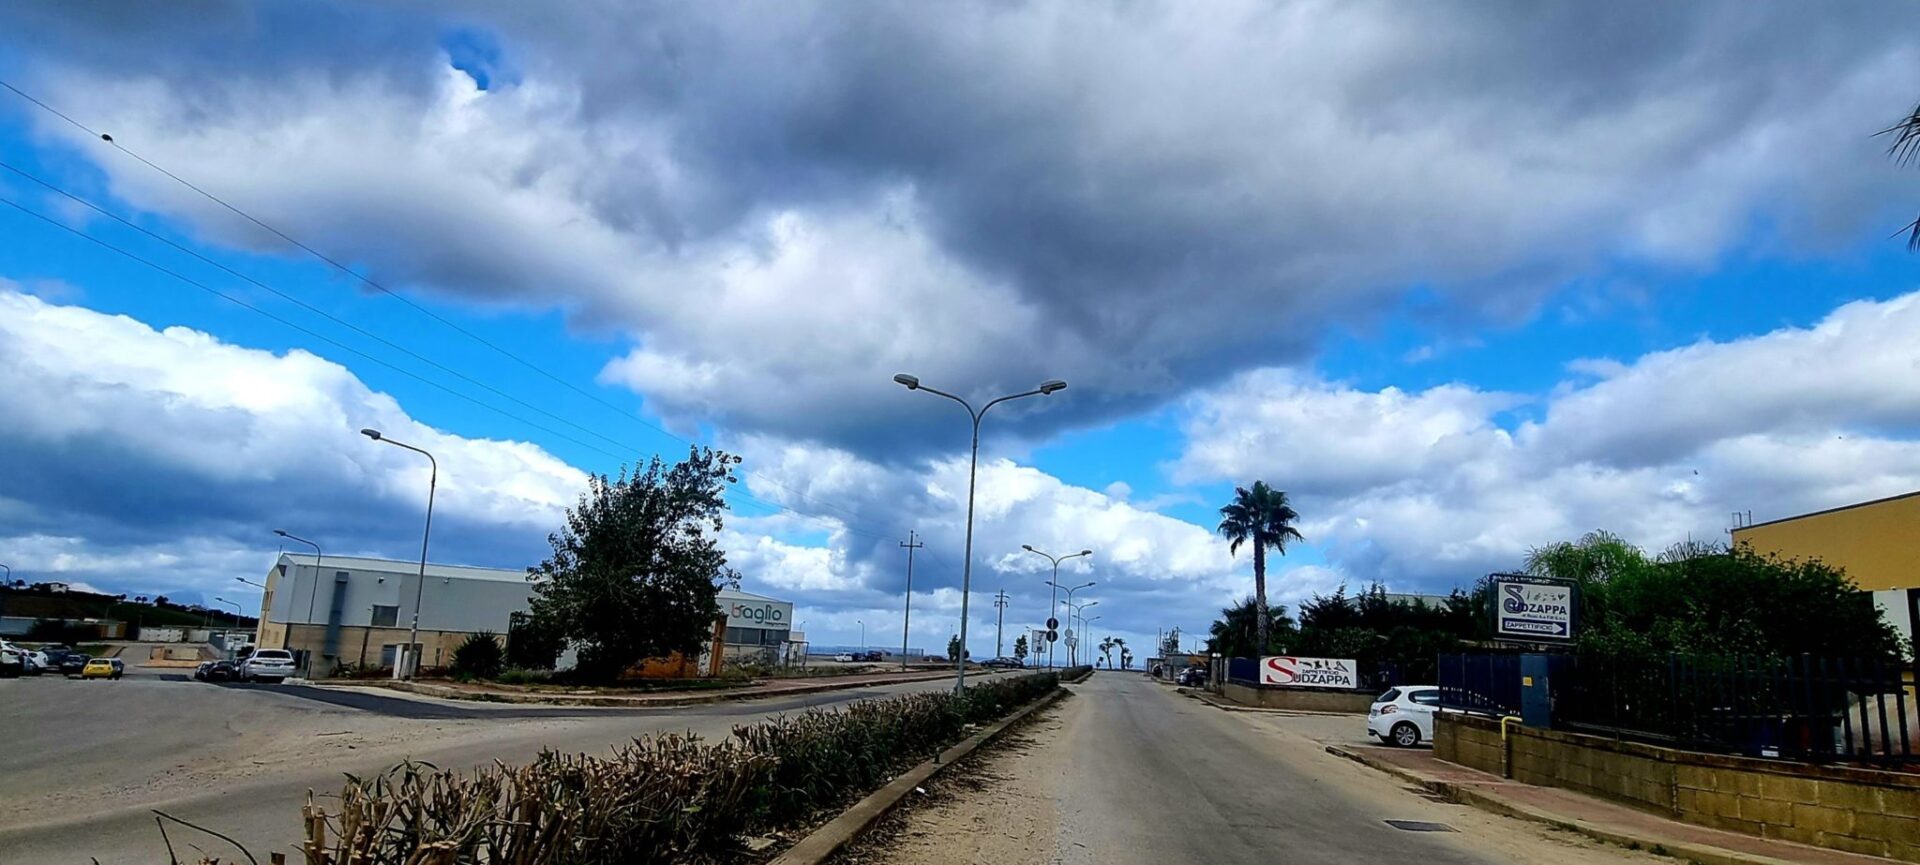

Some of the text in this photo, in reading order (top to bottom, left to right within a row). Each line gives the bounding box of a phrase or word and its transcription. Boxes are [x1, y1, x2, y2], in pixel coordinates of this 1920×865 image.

[731, 602, 782, 624] baglio
[1506, 621, 1553, 631] ZAPPETTIFICIO
[1266, 657, 1351, 686] SUDZAPPA
